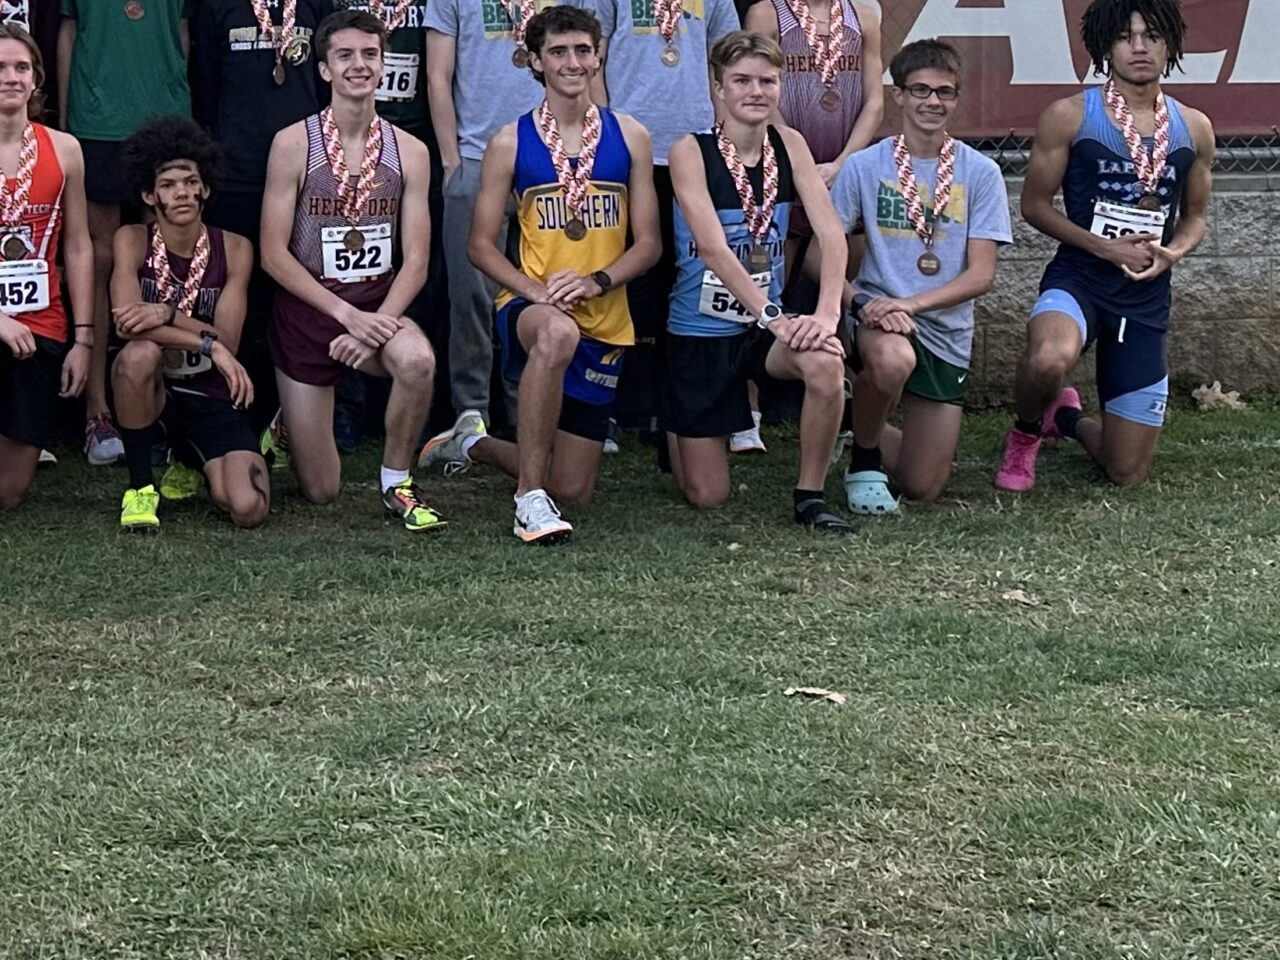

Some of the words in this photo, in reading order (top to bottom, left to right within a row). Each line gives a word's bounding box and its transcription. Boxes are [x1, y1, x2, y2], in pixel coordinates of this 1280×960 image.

[536, 194, 620, 230] SOUHERN
[335, 245, 382, 272] 522
[712, 292, 752, 316] 54
